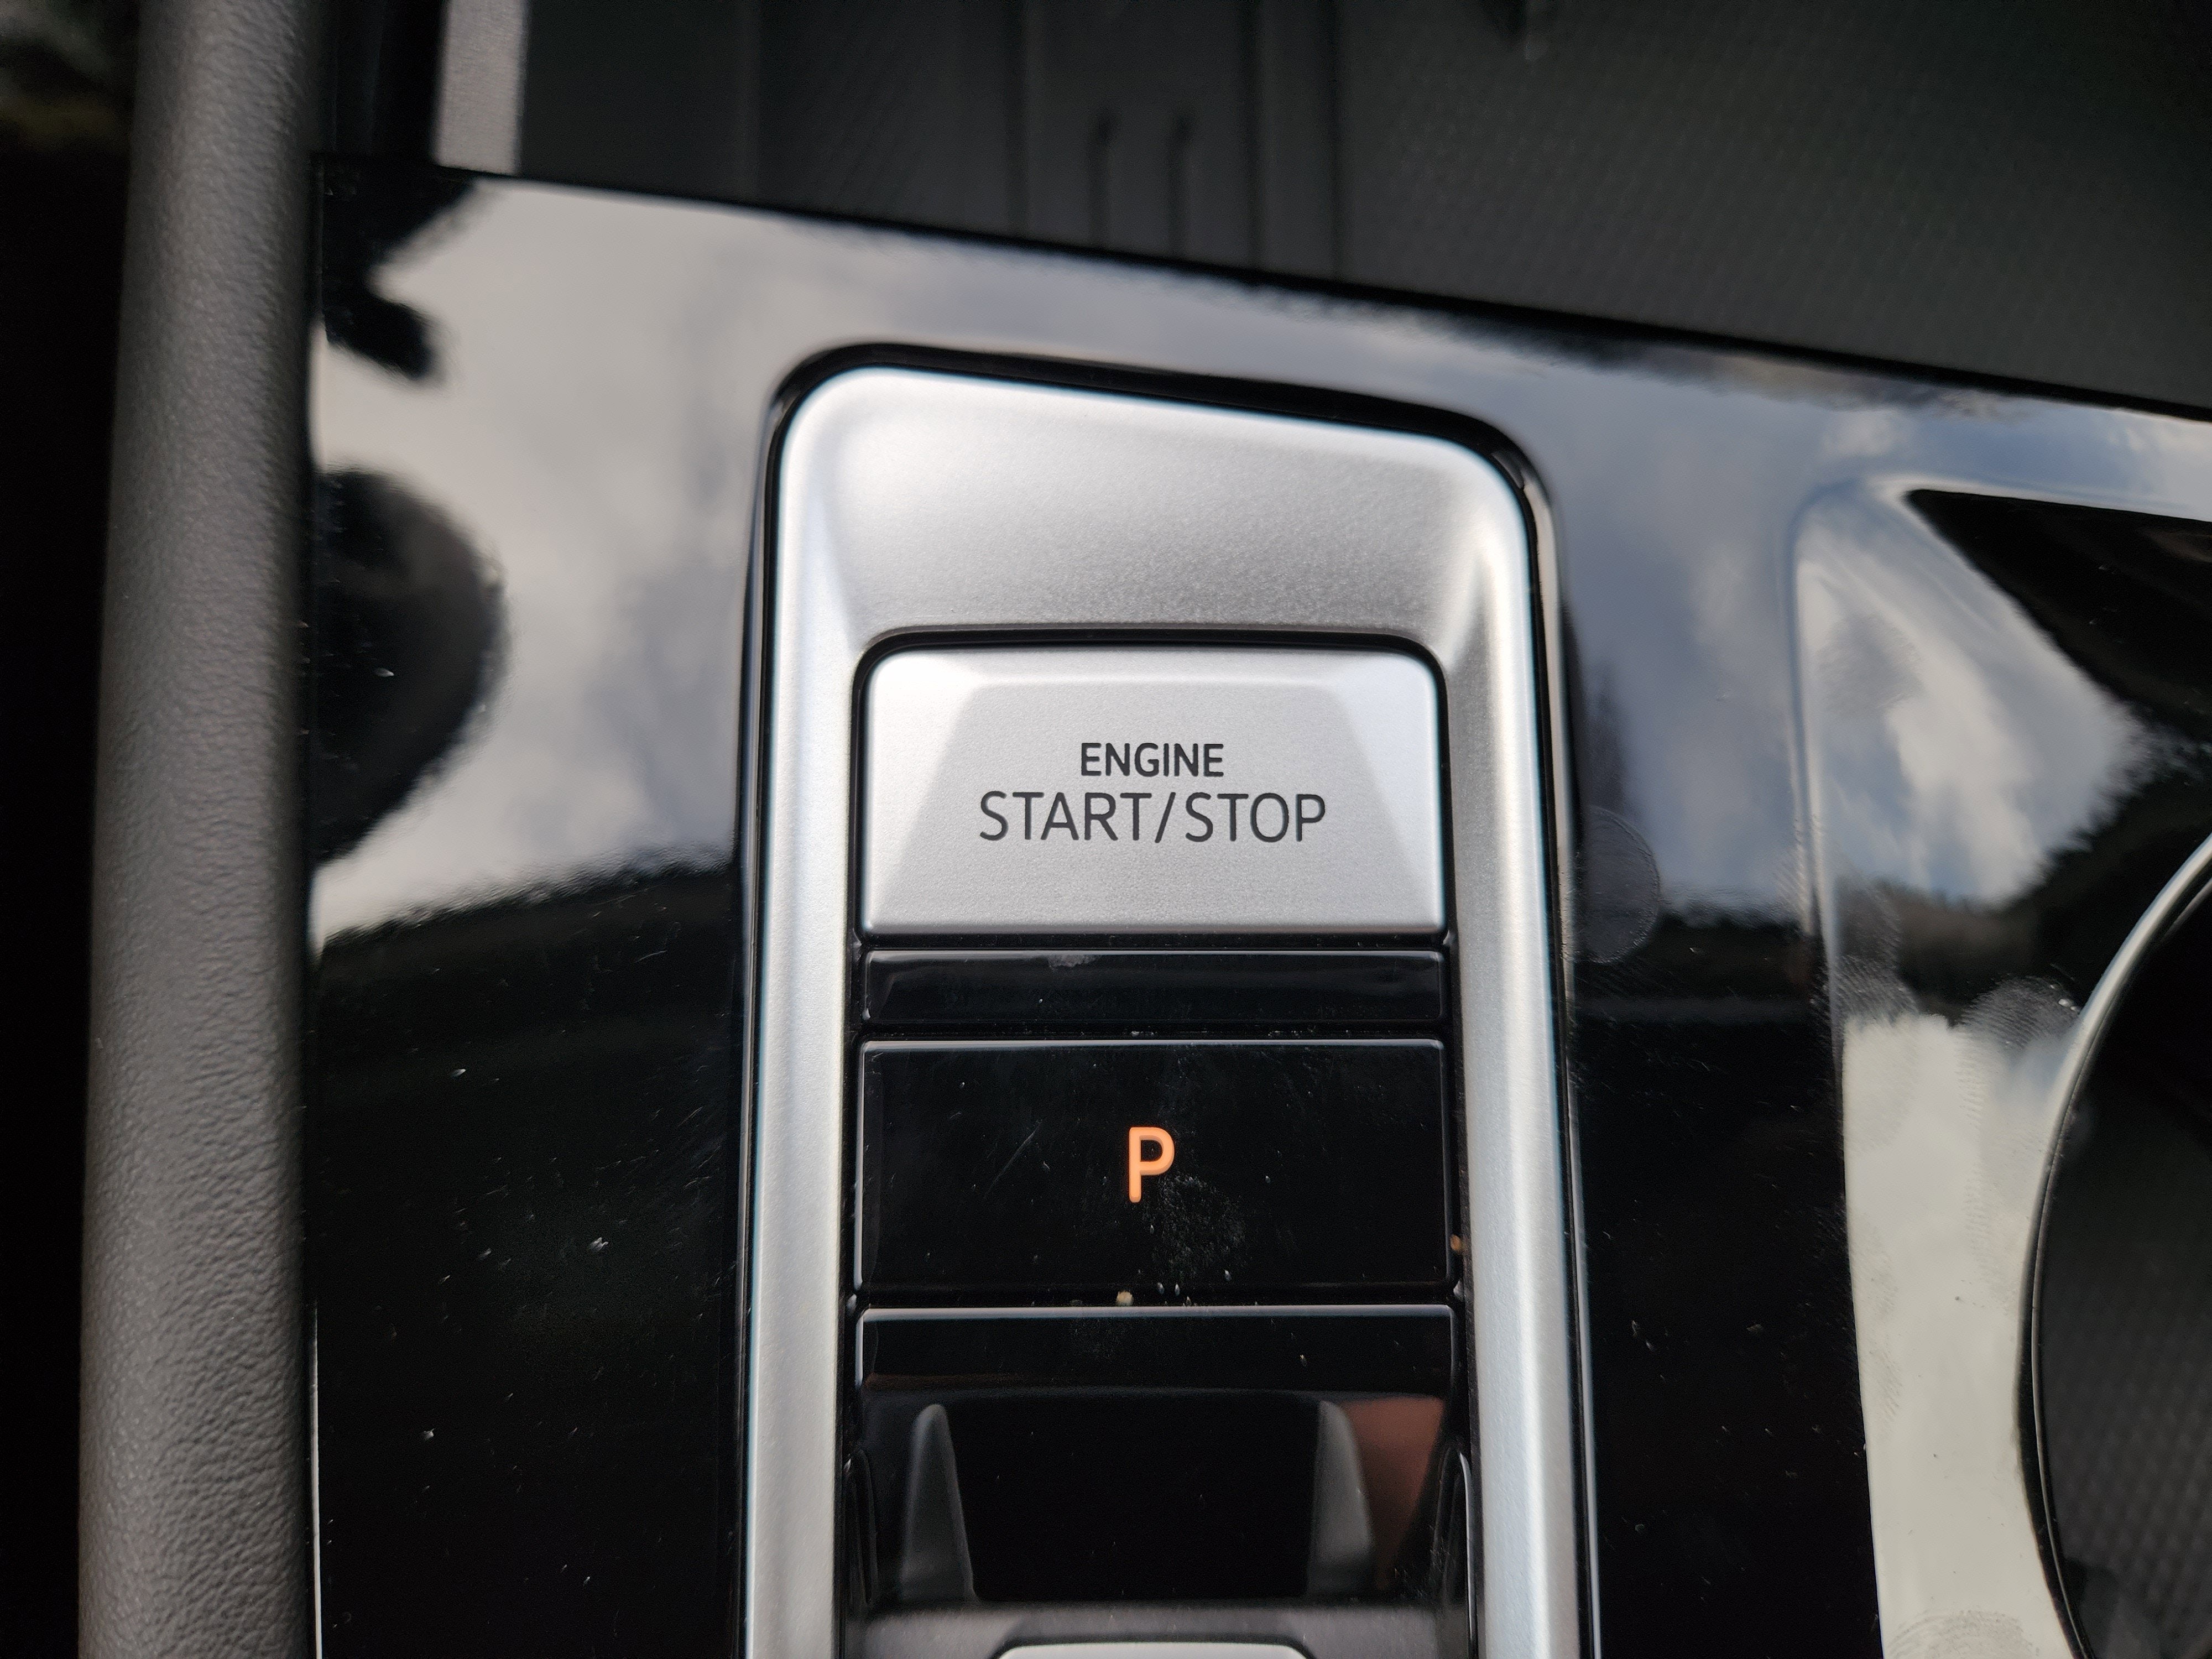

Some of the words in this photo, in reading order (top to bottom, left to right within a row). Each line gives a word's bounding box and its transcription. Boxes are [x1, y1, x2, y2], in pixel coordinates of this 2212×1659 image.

[1080, 742, 1225, 778] ENGINE
[979, 790, 1327, 843] START/STOP
[1126, 1125, 1177, 1204] P
